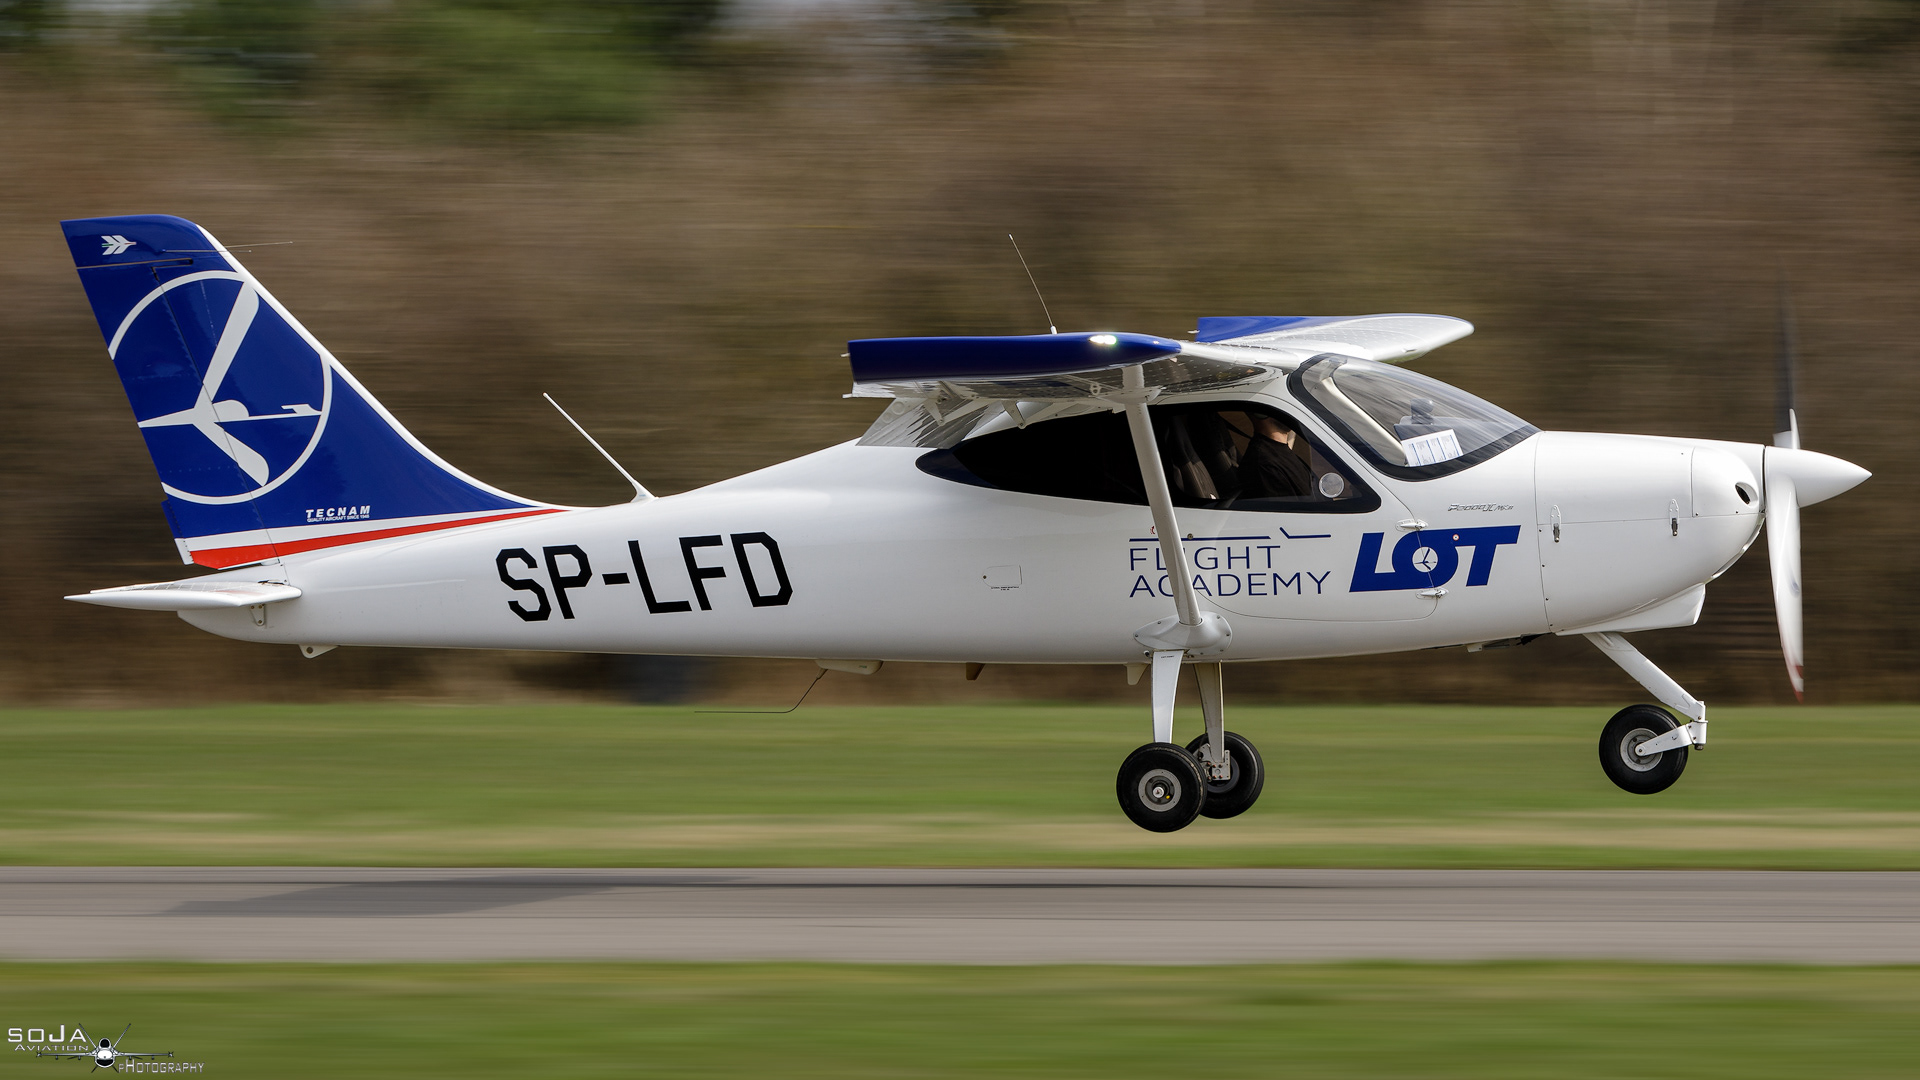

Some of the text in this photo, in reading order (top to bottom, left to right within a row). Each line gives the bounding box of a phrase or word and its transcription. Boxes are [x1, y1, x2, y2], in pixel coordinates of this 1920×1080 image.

[305, 505, 371, 518] TECNAM
[495, 531, 794, 622] SP-LFD
[1129, 545, 1281, 571] FLGHT
[1349, 525, 1521, 592] LOT
